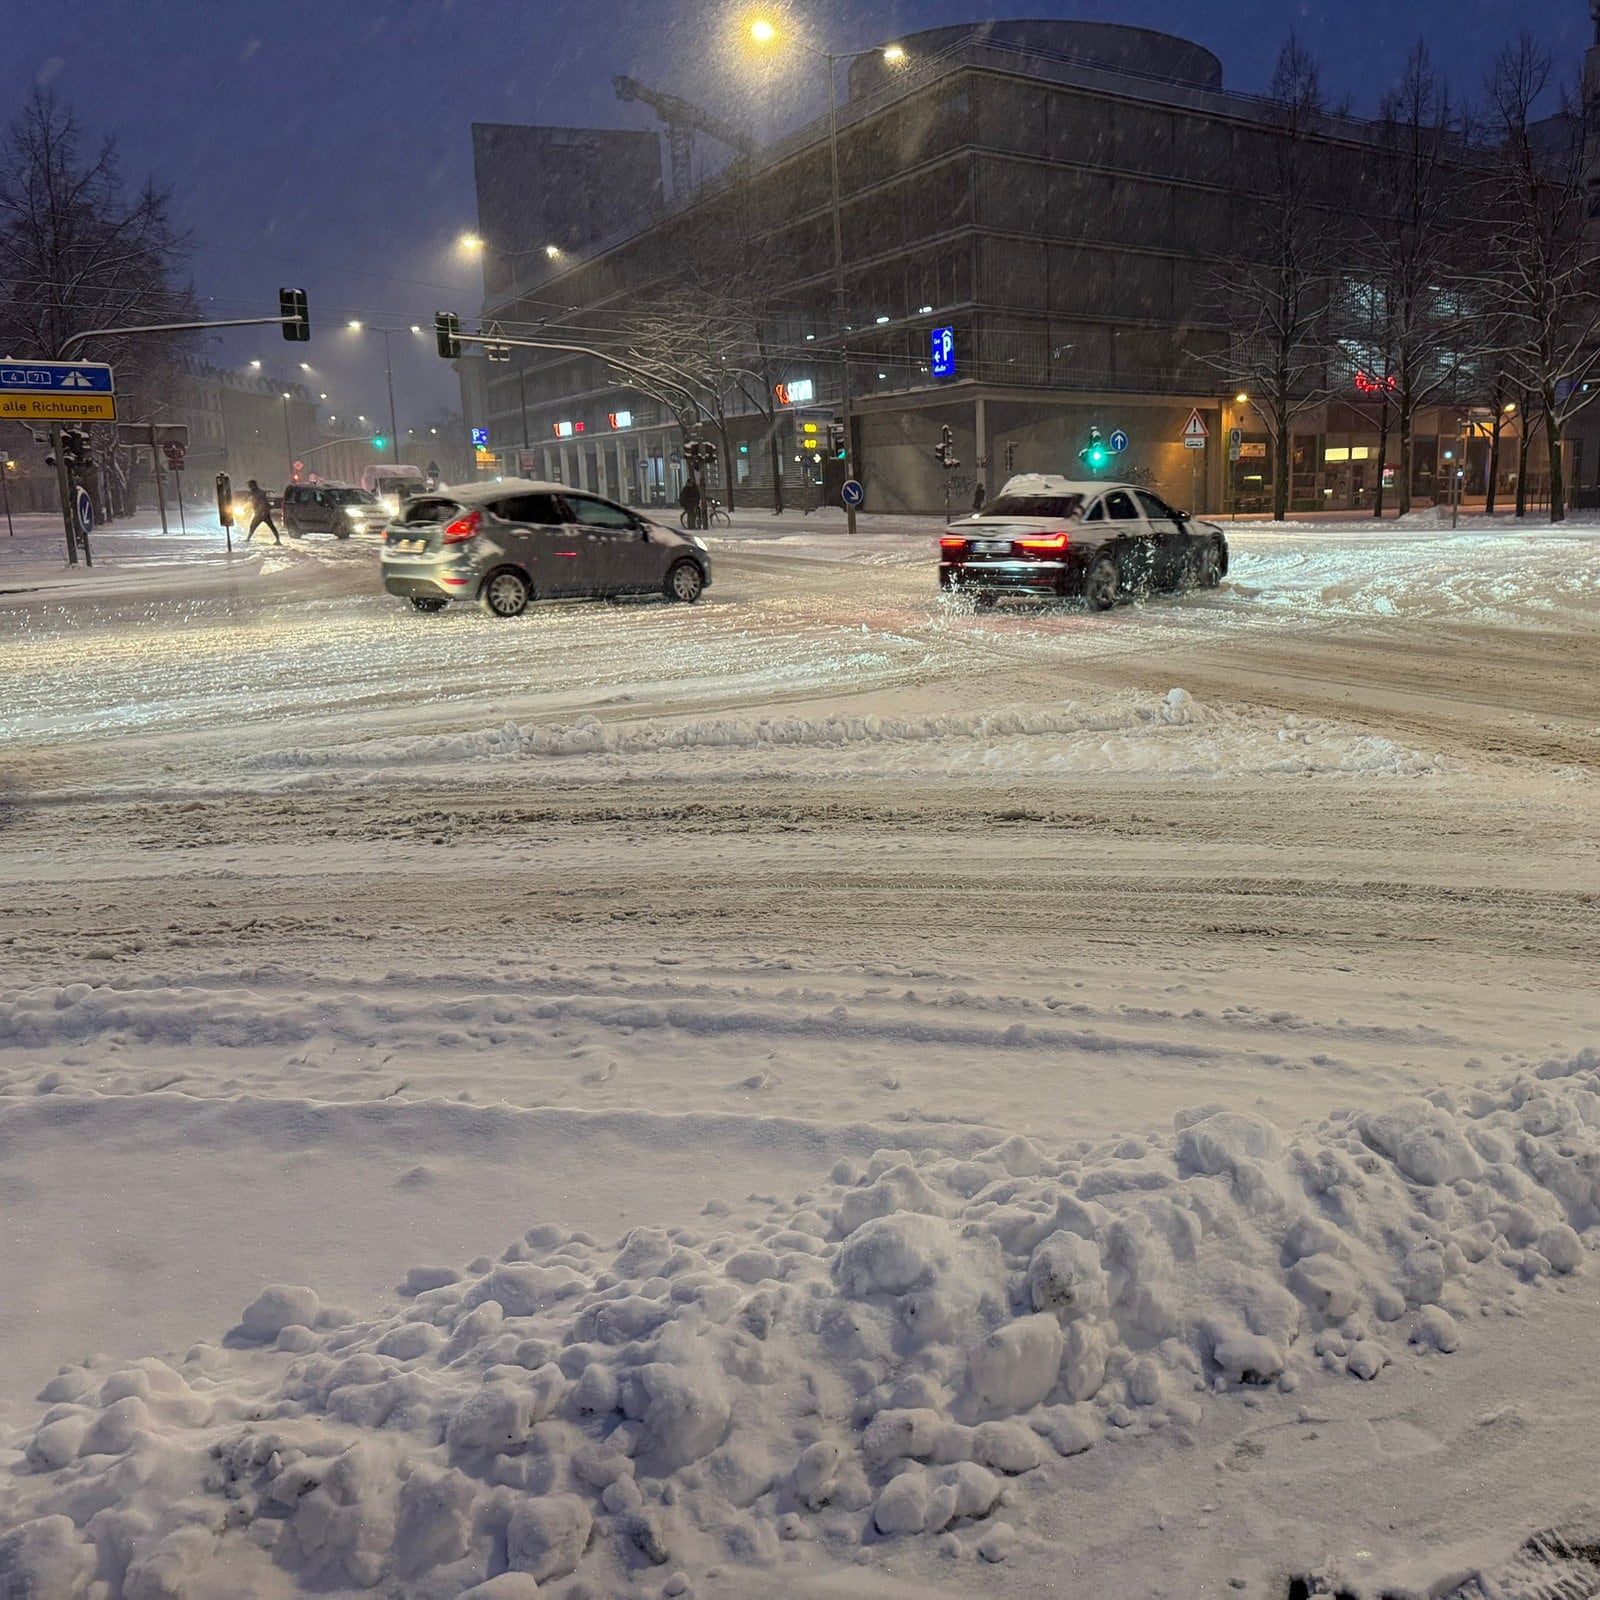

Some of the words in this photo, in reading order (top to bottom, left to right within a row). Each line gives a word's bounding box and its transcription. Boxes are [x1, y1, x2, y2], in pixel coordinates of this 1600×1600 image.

[943, 336, 952, 361] P
[11, 373, 17, 381] 4
[34, 373, 45, 382] 71
[3, 401, 27, 411] alle
[32, 401, 103, 415] Richtungen
